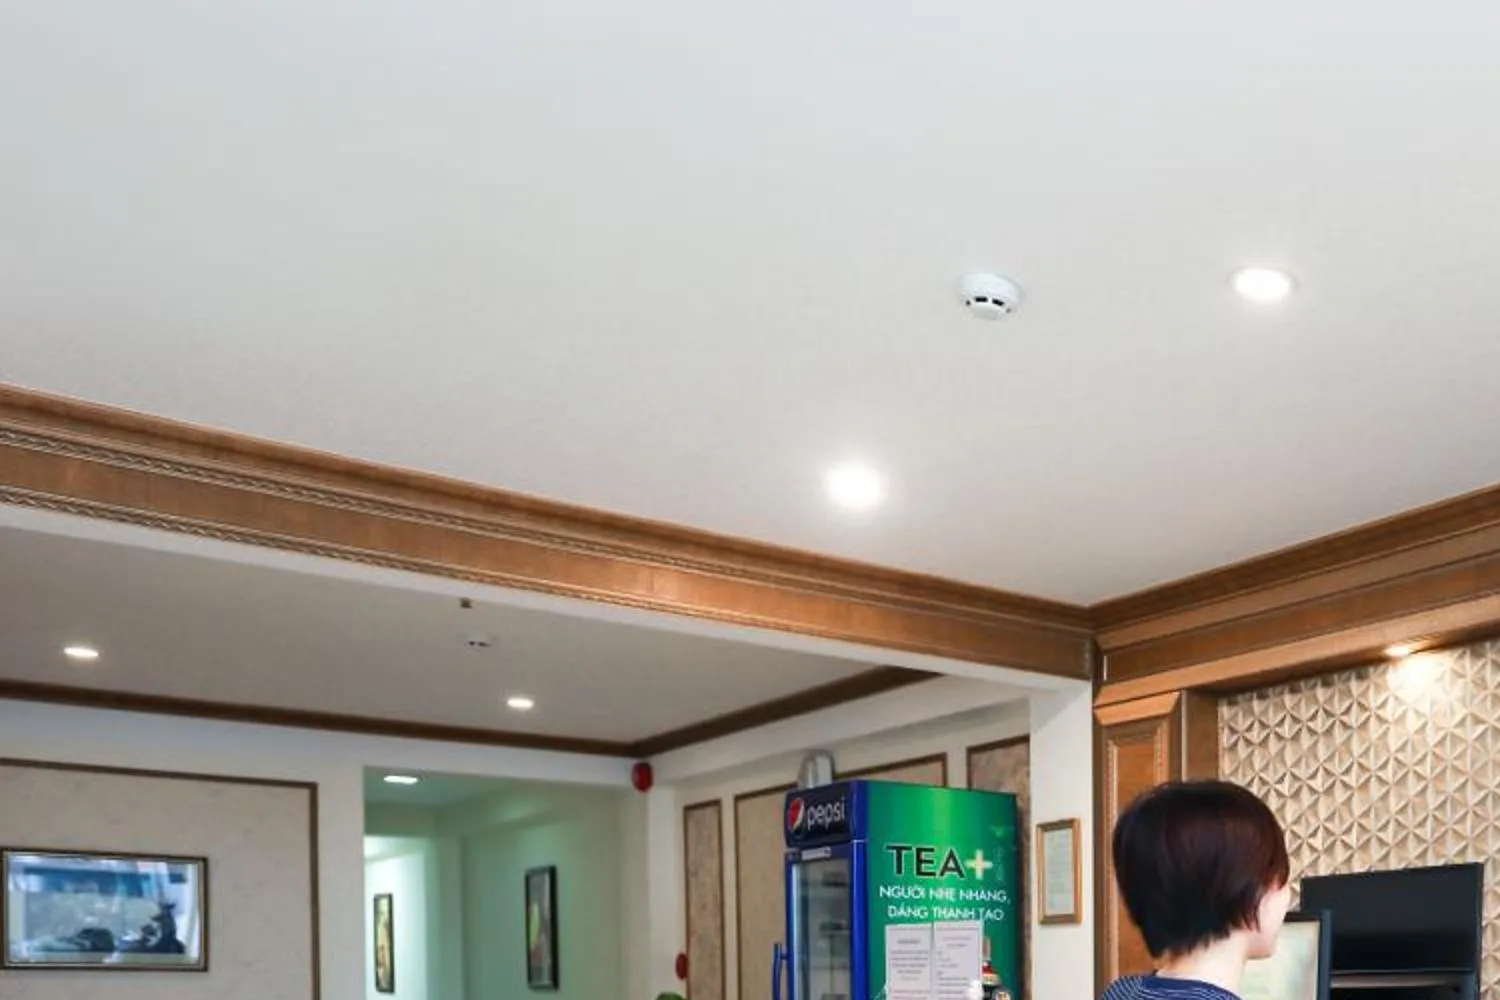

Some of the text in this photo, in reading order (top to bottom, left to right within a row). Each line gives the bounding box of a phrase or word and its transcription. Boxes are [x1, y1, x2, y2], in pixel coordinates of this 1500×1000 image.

[807, 794, 846, 832] pepsi
[882, 843, 994, 881] TEA+
[932, 906, 976, 920] THANH
